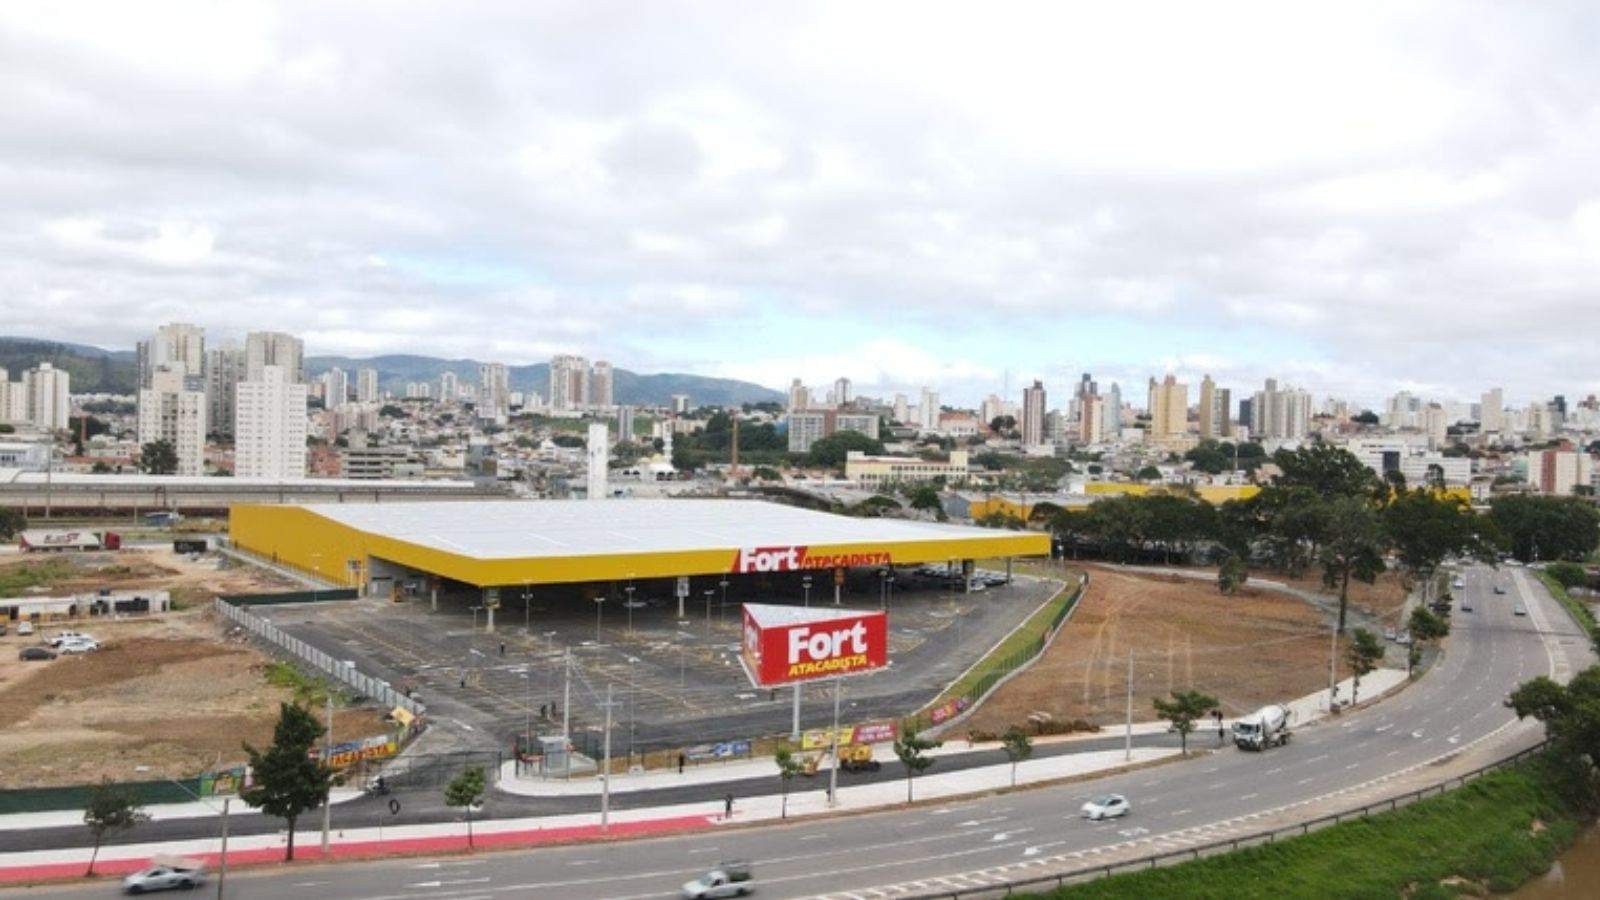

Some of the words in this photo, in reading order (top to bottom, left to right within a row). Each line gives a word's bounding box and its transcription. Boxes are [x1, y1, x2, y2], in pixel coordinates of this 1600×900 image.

[740, 547, 798, 572] Fort
[801, 553, 891, 569] ATACADISTA
[788, 621, 867, 664] Fort
[788, 655, 867, 677] ATACADISTA
